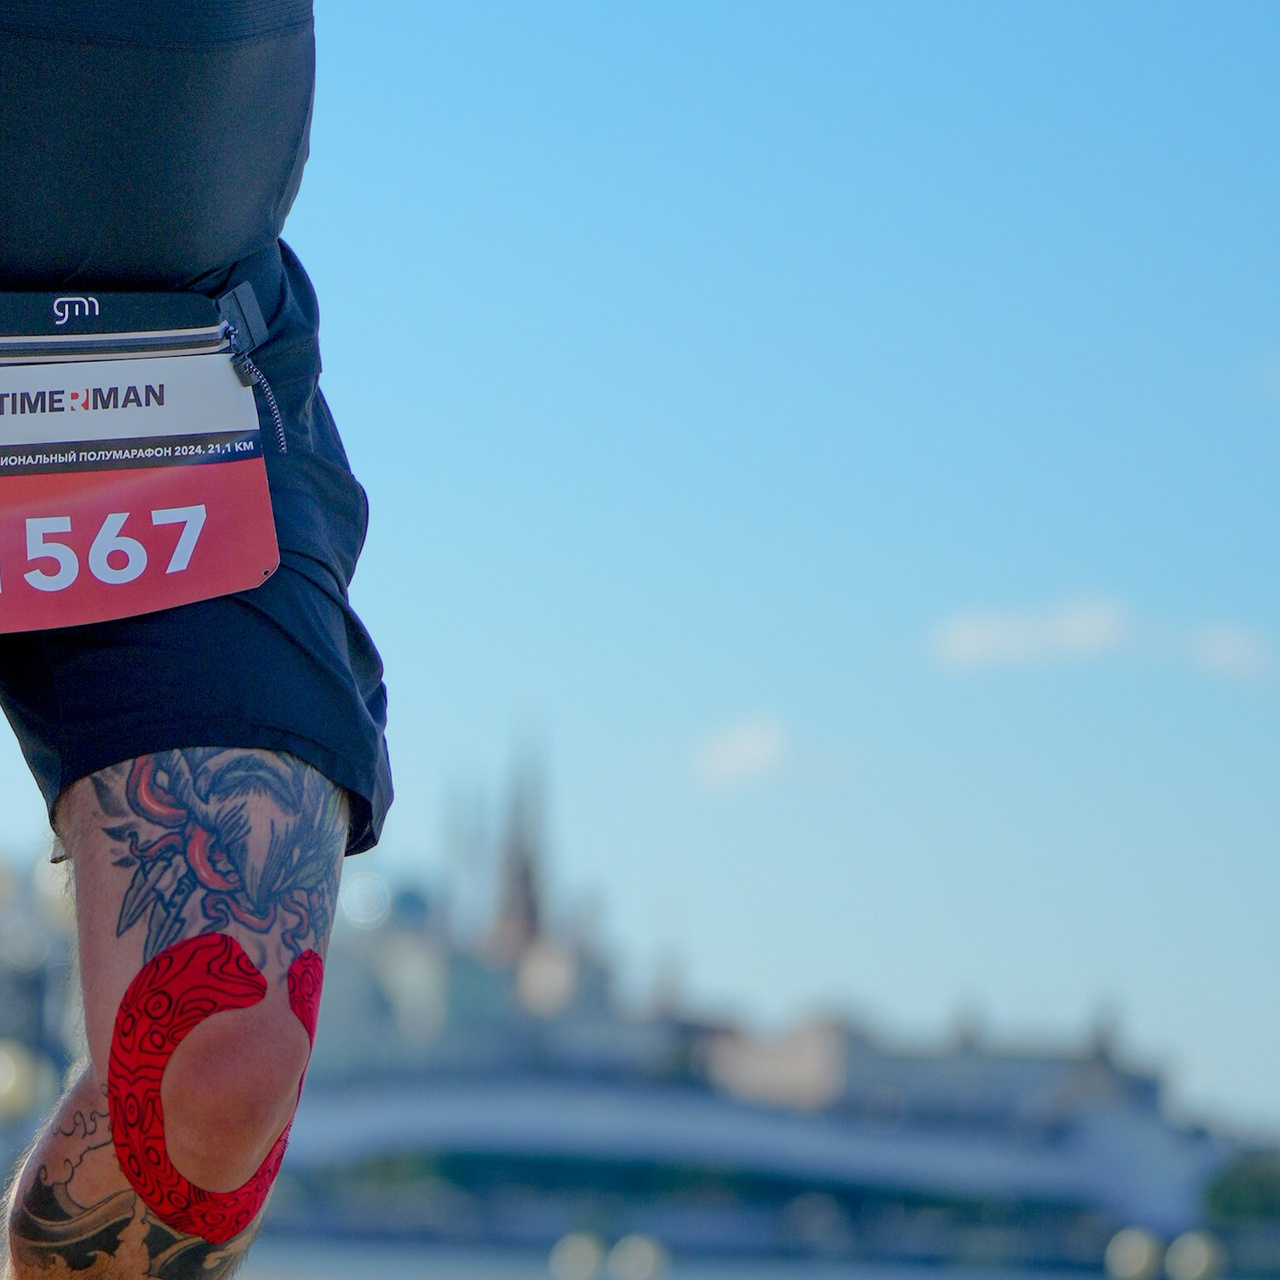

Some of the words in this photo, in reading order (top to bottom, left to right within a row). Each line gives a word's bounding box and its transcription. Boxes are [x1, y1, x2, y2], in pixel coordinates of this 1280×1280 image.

[79, 446, 172, 462] ПОЛУМАРАФОН
[174, 444, 206, 456] 2024.
[207, 442, 231, 455] 21,1
[234, 440, 254, 452] КМ
